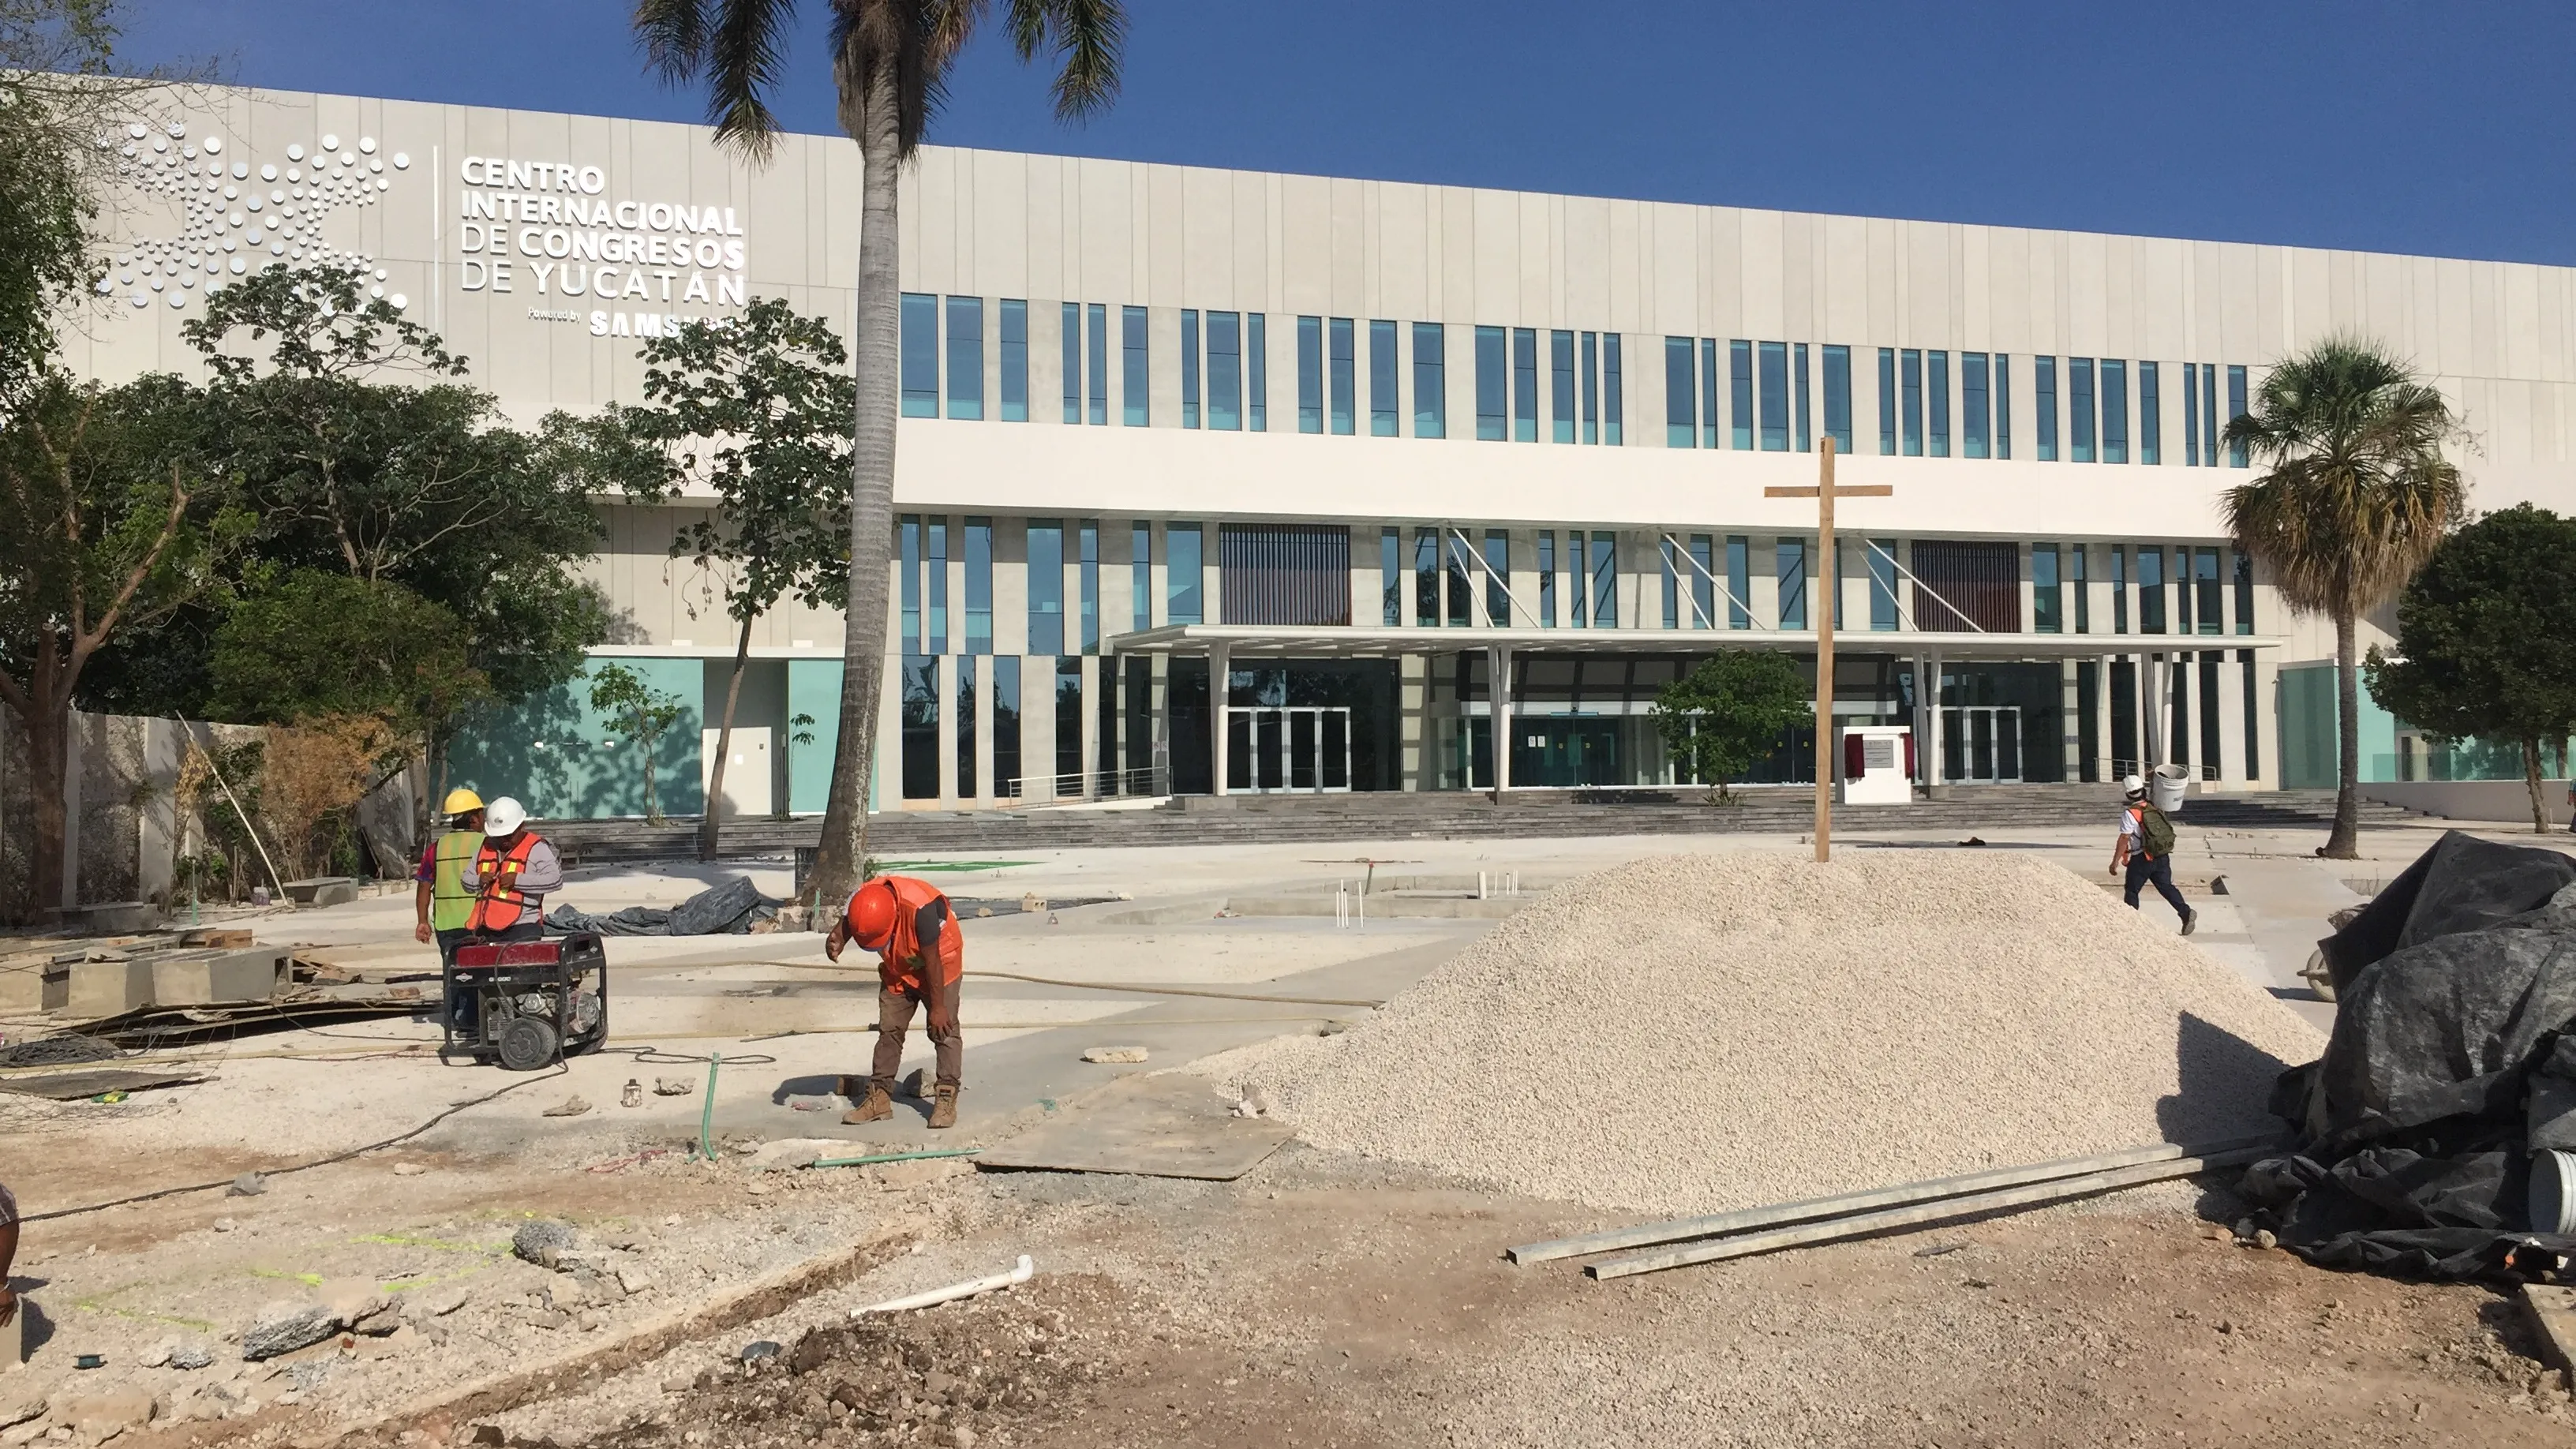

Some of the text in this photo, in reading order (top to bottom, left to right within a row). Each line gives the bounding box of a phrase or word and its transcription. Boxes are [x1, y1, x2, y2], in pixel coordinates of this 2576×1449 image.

[462, 156, 605, 195] CENTRO
[462, 189, 743, 236] INTERNACIONAL
[462, 223, 745, 271] DE CONGRESOS
[462, 258, 744, 307] DE YUCATÁN
[528, 306, 567, 321] Powered
[570, 309, 581, 324] by
